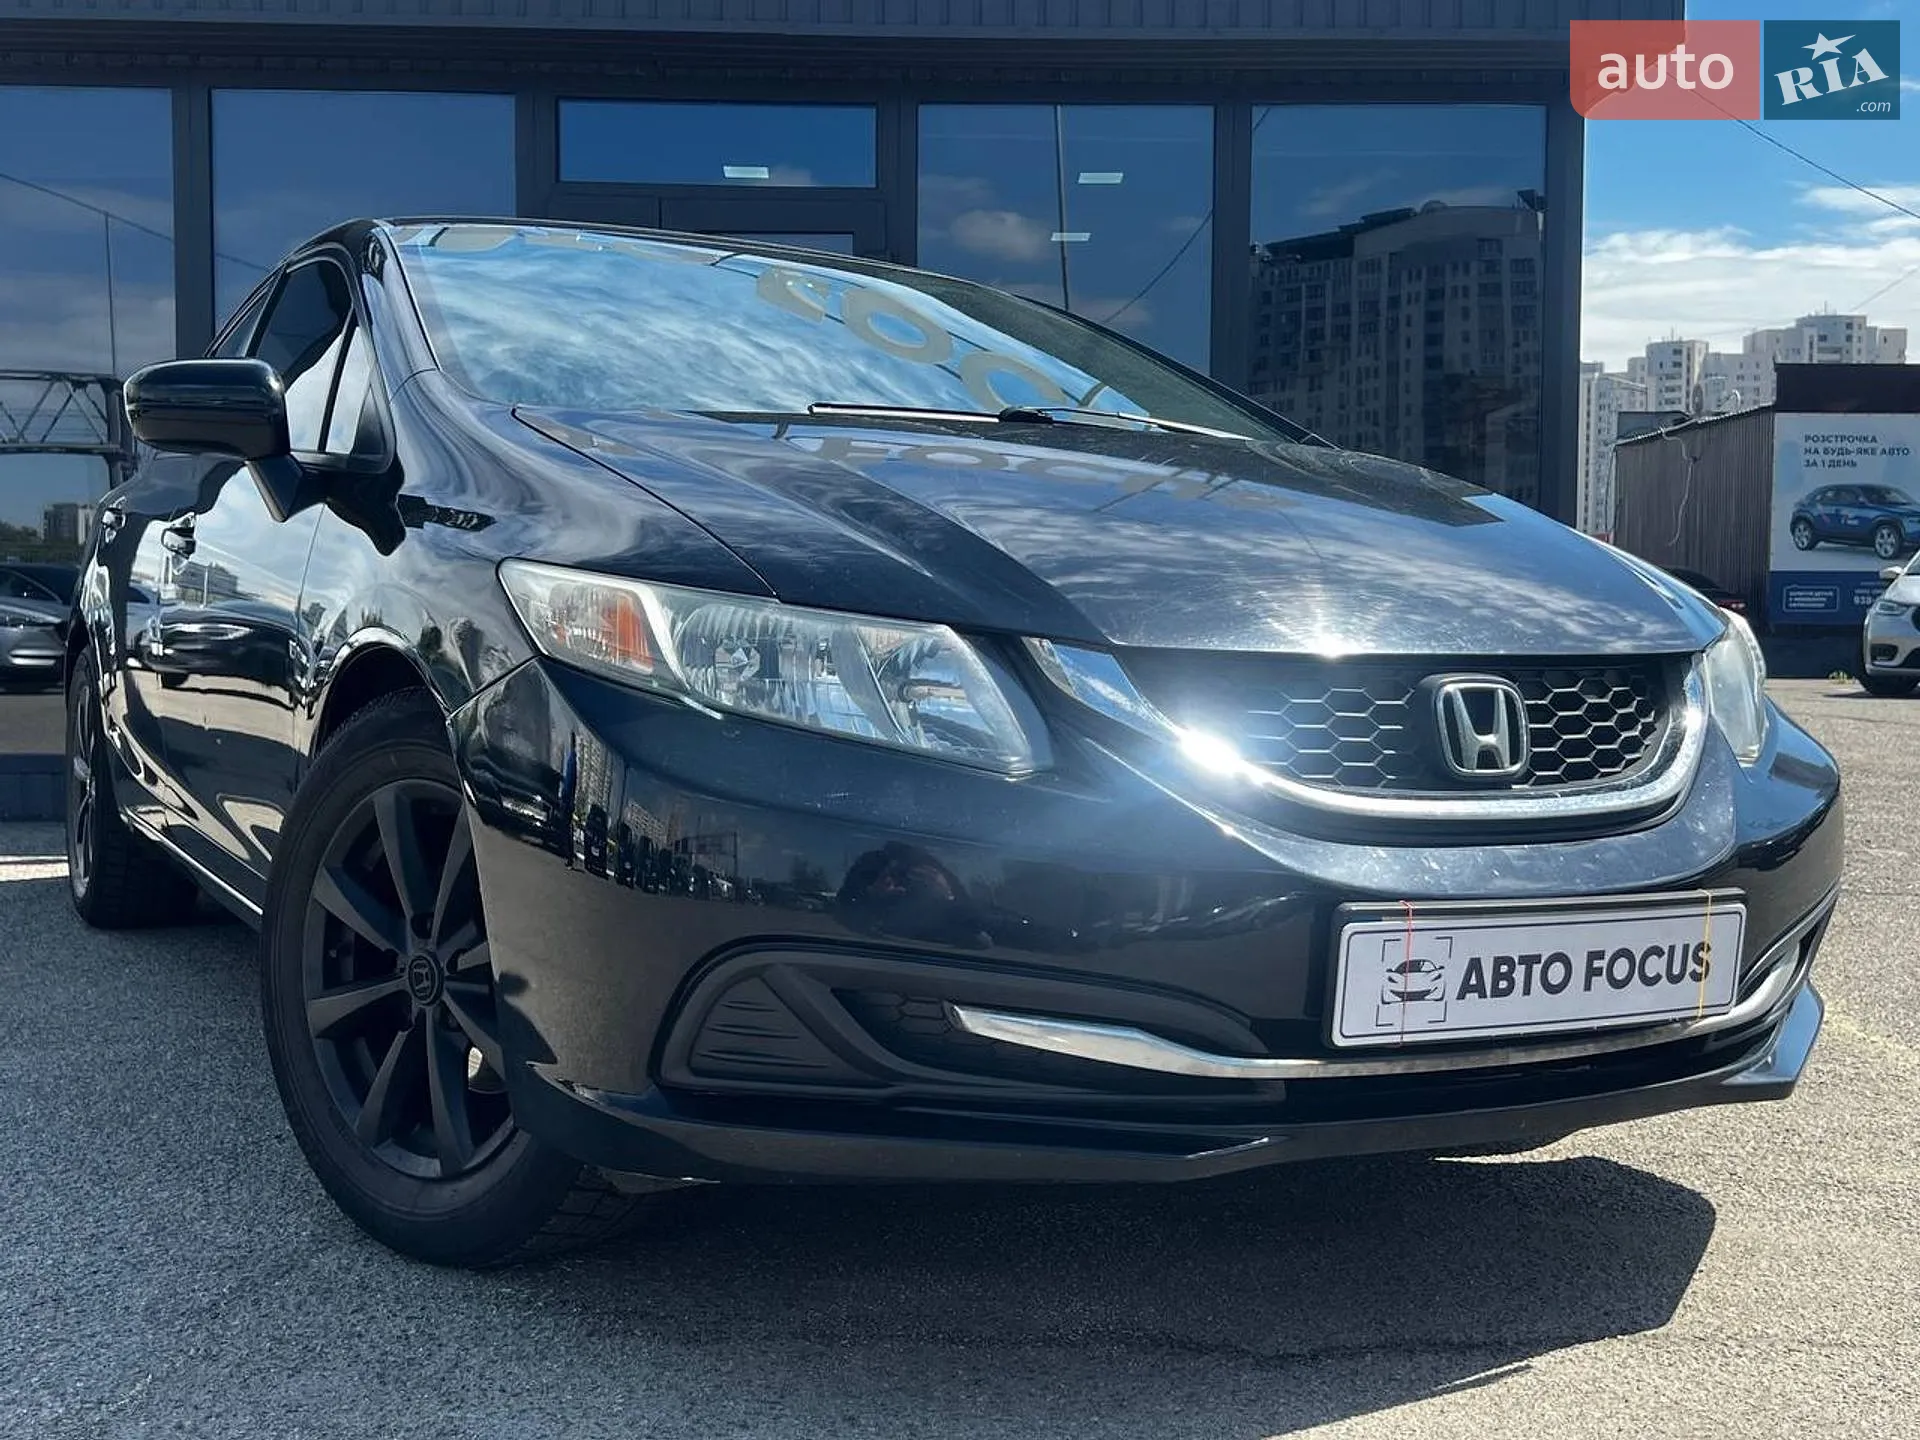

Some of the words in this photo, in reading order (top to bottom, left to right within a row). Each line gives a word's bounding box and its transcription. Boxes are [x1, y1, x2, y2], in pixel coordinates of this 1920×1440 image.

[1804, 434, 1878, 443] РОЗСТРОЧКА
[1804, 447, 1820, 456] НА
[1822, 447, 1877, 456] БУДЬ-ЯКЕ
[1880, 447, 1910, 456] АВТО
[1804, 459, 1818, 468] ЗА
[1828, 459, 1857, 469] ДЕНЬ
[1456, 951, 1573, 1001] АВТО
[1584, 941, 1712, 993] FOCUS
